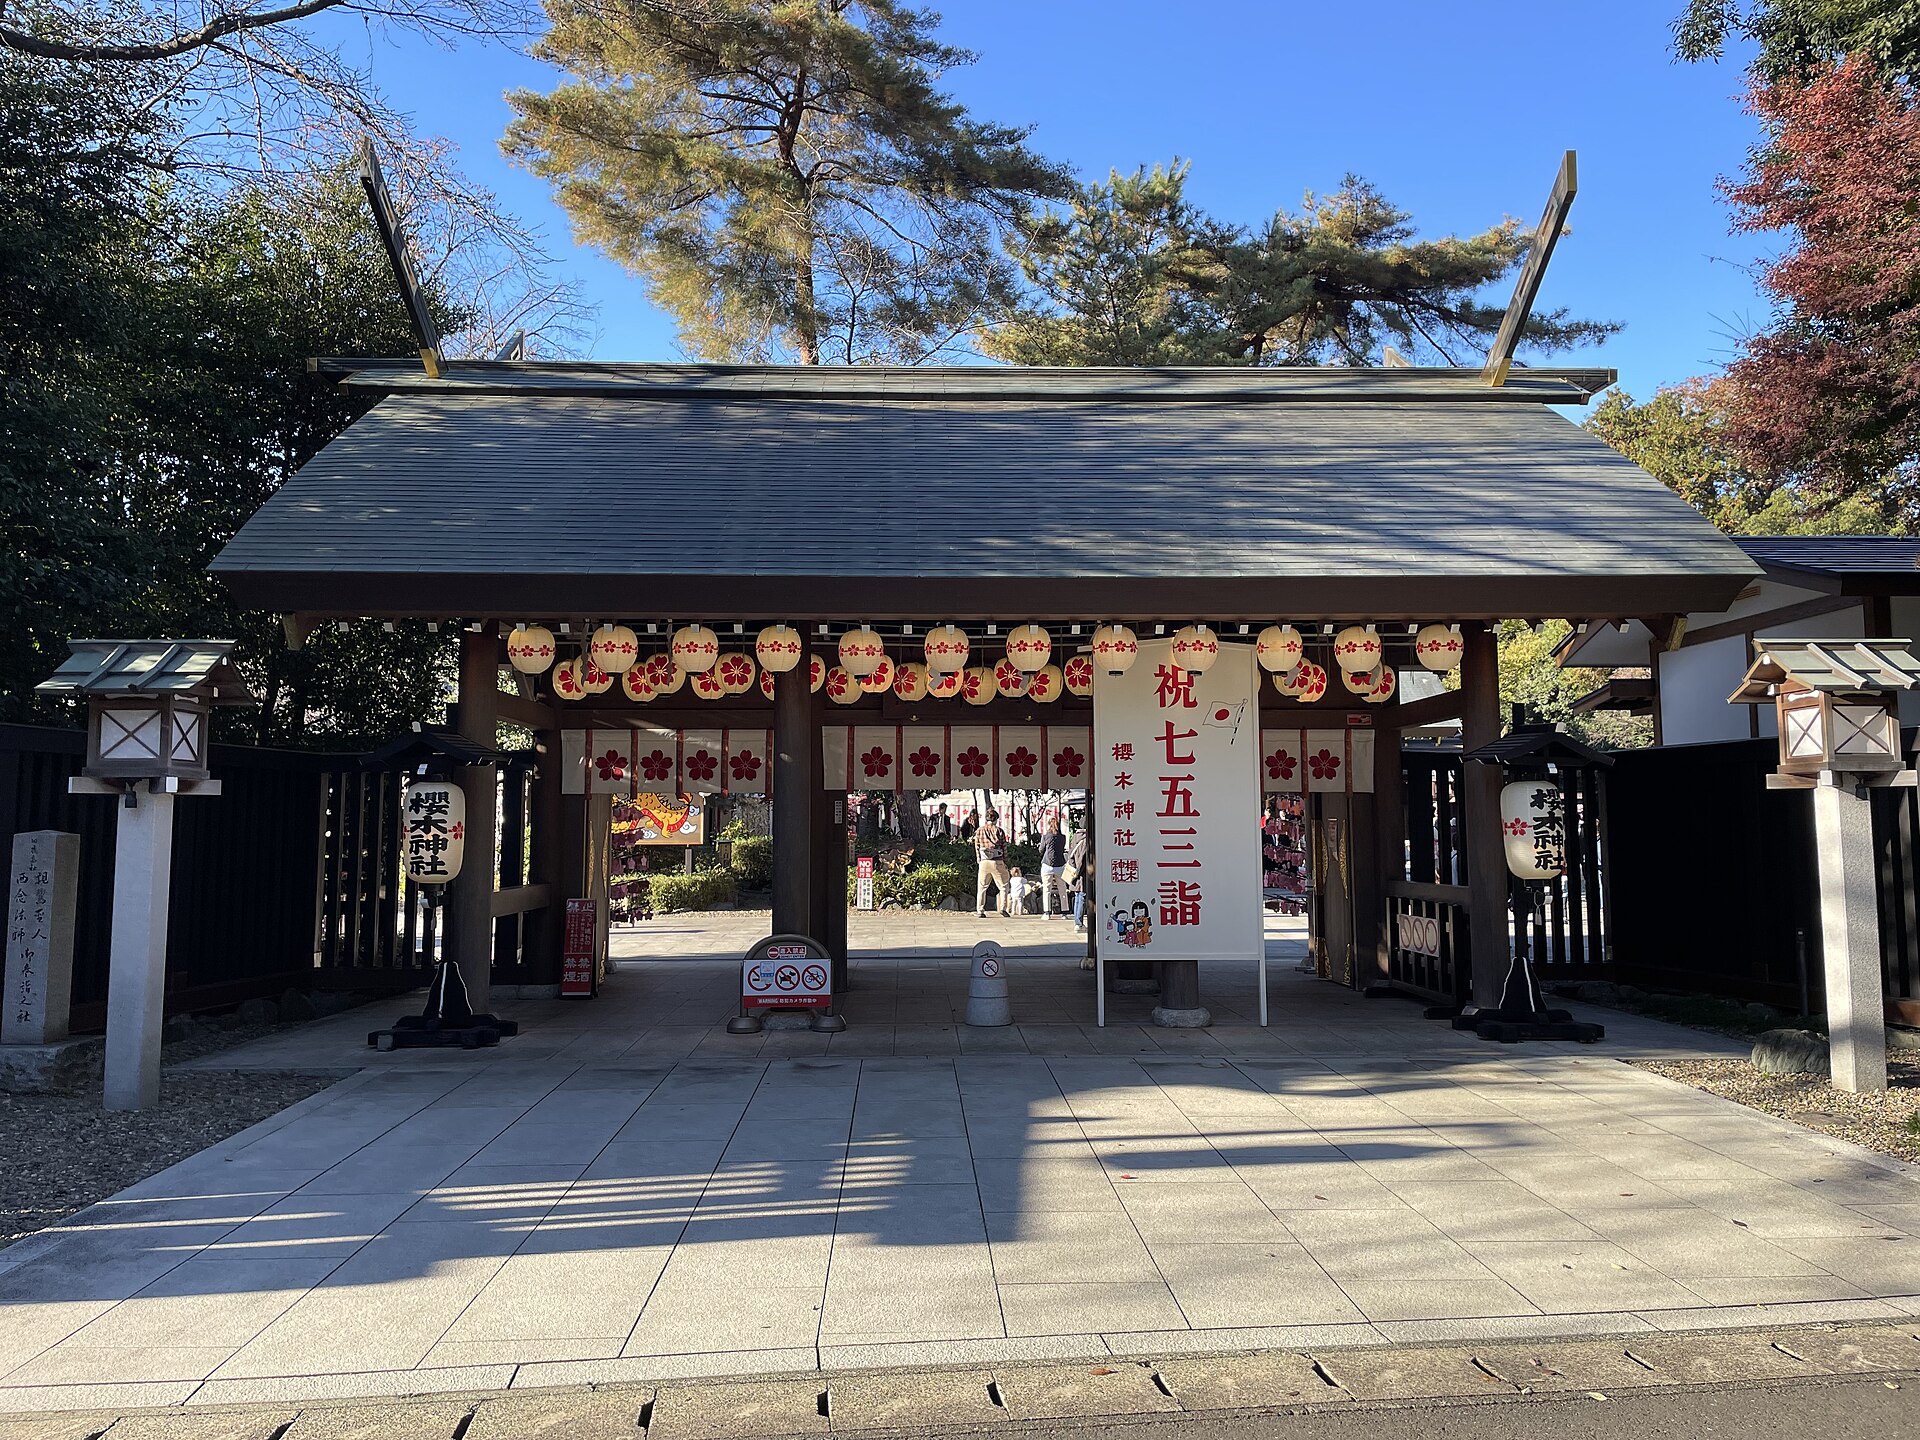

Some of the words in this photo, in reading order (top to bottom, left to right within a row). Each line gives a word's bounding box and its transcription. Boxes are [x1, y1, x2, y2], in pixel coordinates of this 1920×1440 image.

[408, 791, 451, 876] 櫻木神社
[1111, 742, 1137, 847] 櫻木神社
[1153, 663, 1203, 926] 祝七五三詣
[1530, 788, 1564, 870] 櫻木神社
